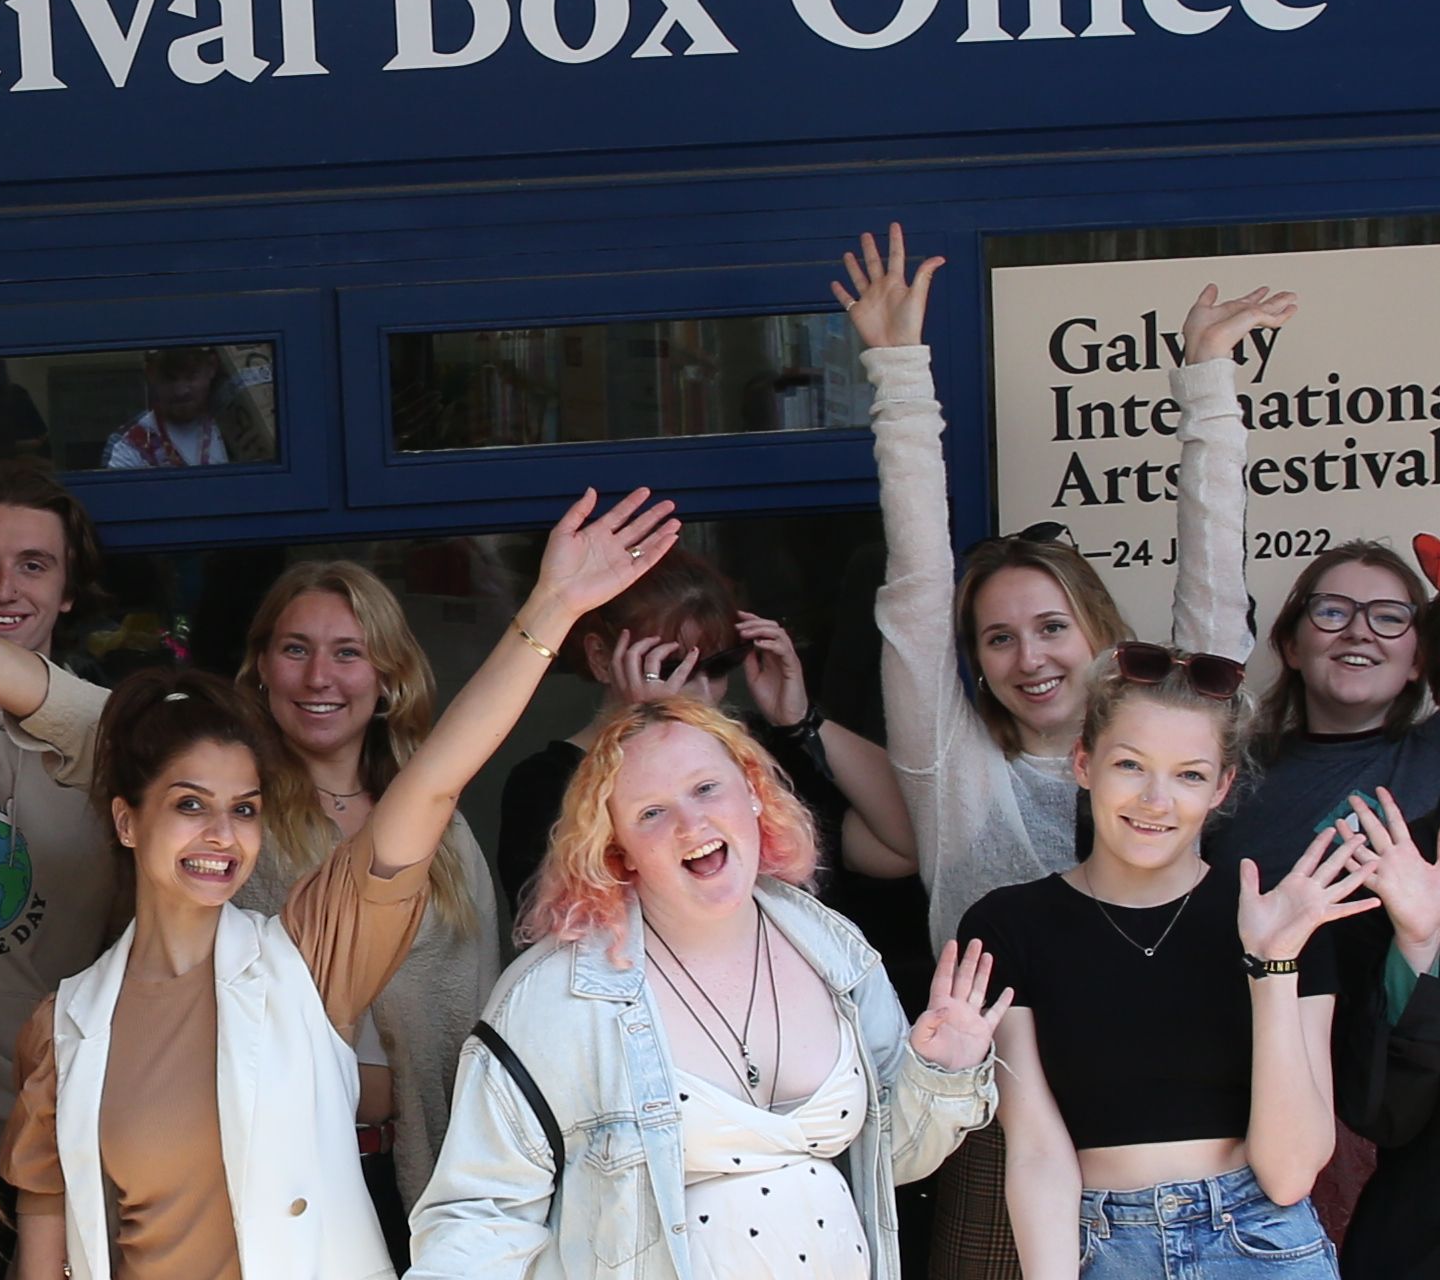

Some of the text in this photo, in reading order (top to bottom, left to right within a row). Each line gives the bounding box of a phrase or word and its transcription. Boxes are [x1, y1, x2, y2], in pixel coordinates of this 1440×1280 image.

[1048, 310, 1281, 384] Galy
[1254, 528, 1332, 560] 2022
[11, 892, 47, 945] DAY
